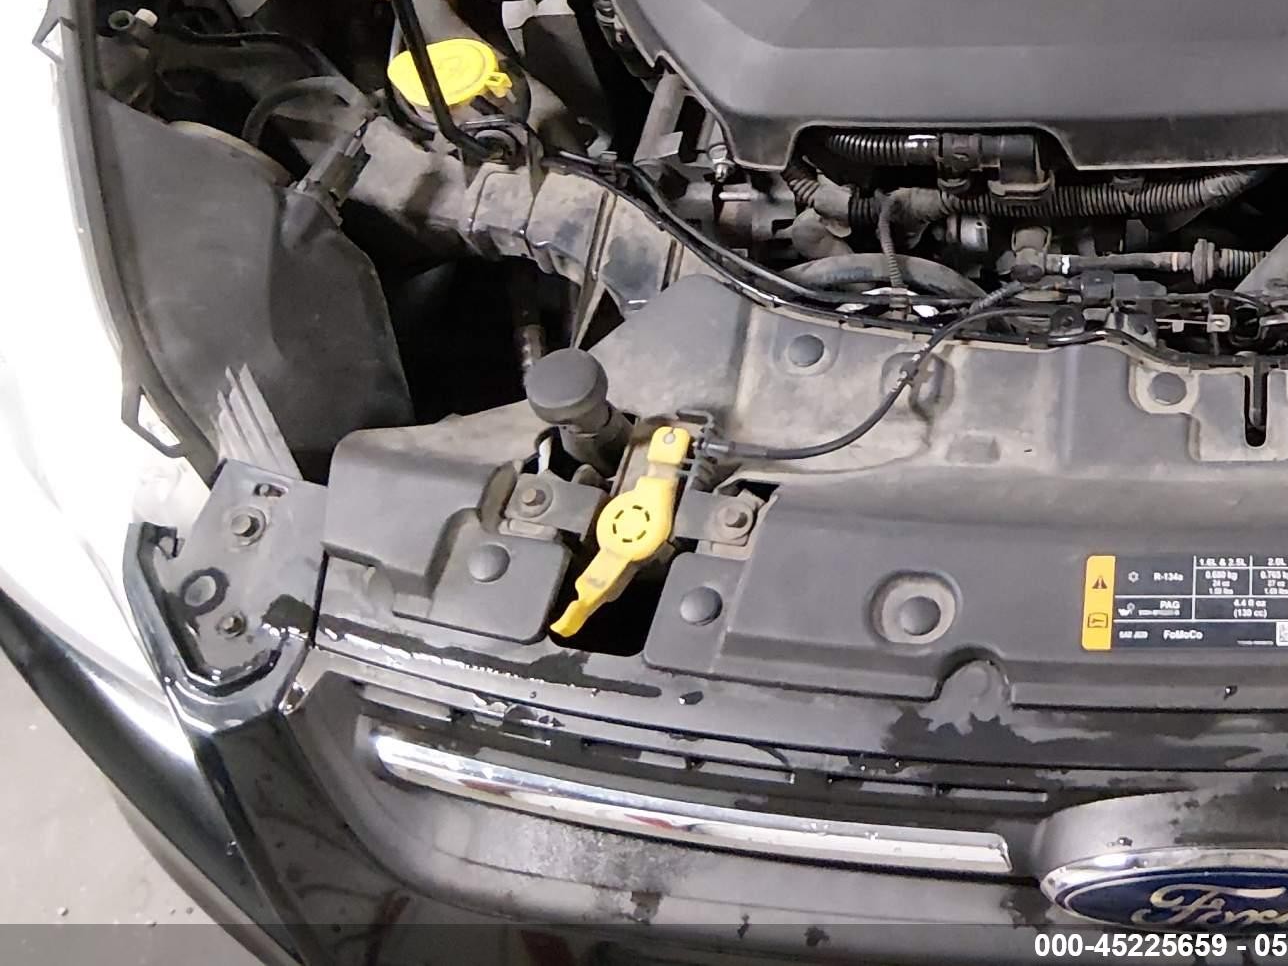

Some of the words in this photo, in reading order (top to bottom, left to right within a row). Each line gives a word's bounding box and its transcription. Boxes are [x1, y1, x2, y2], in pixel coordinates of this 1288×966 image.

[1153, 572, 1184, 582] R-134a
[1160, 600, 1181, 610] PAG
[1163, 630, 1204, 640] FoMoCo
